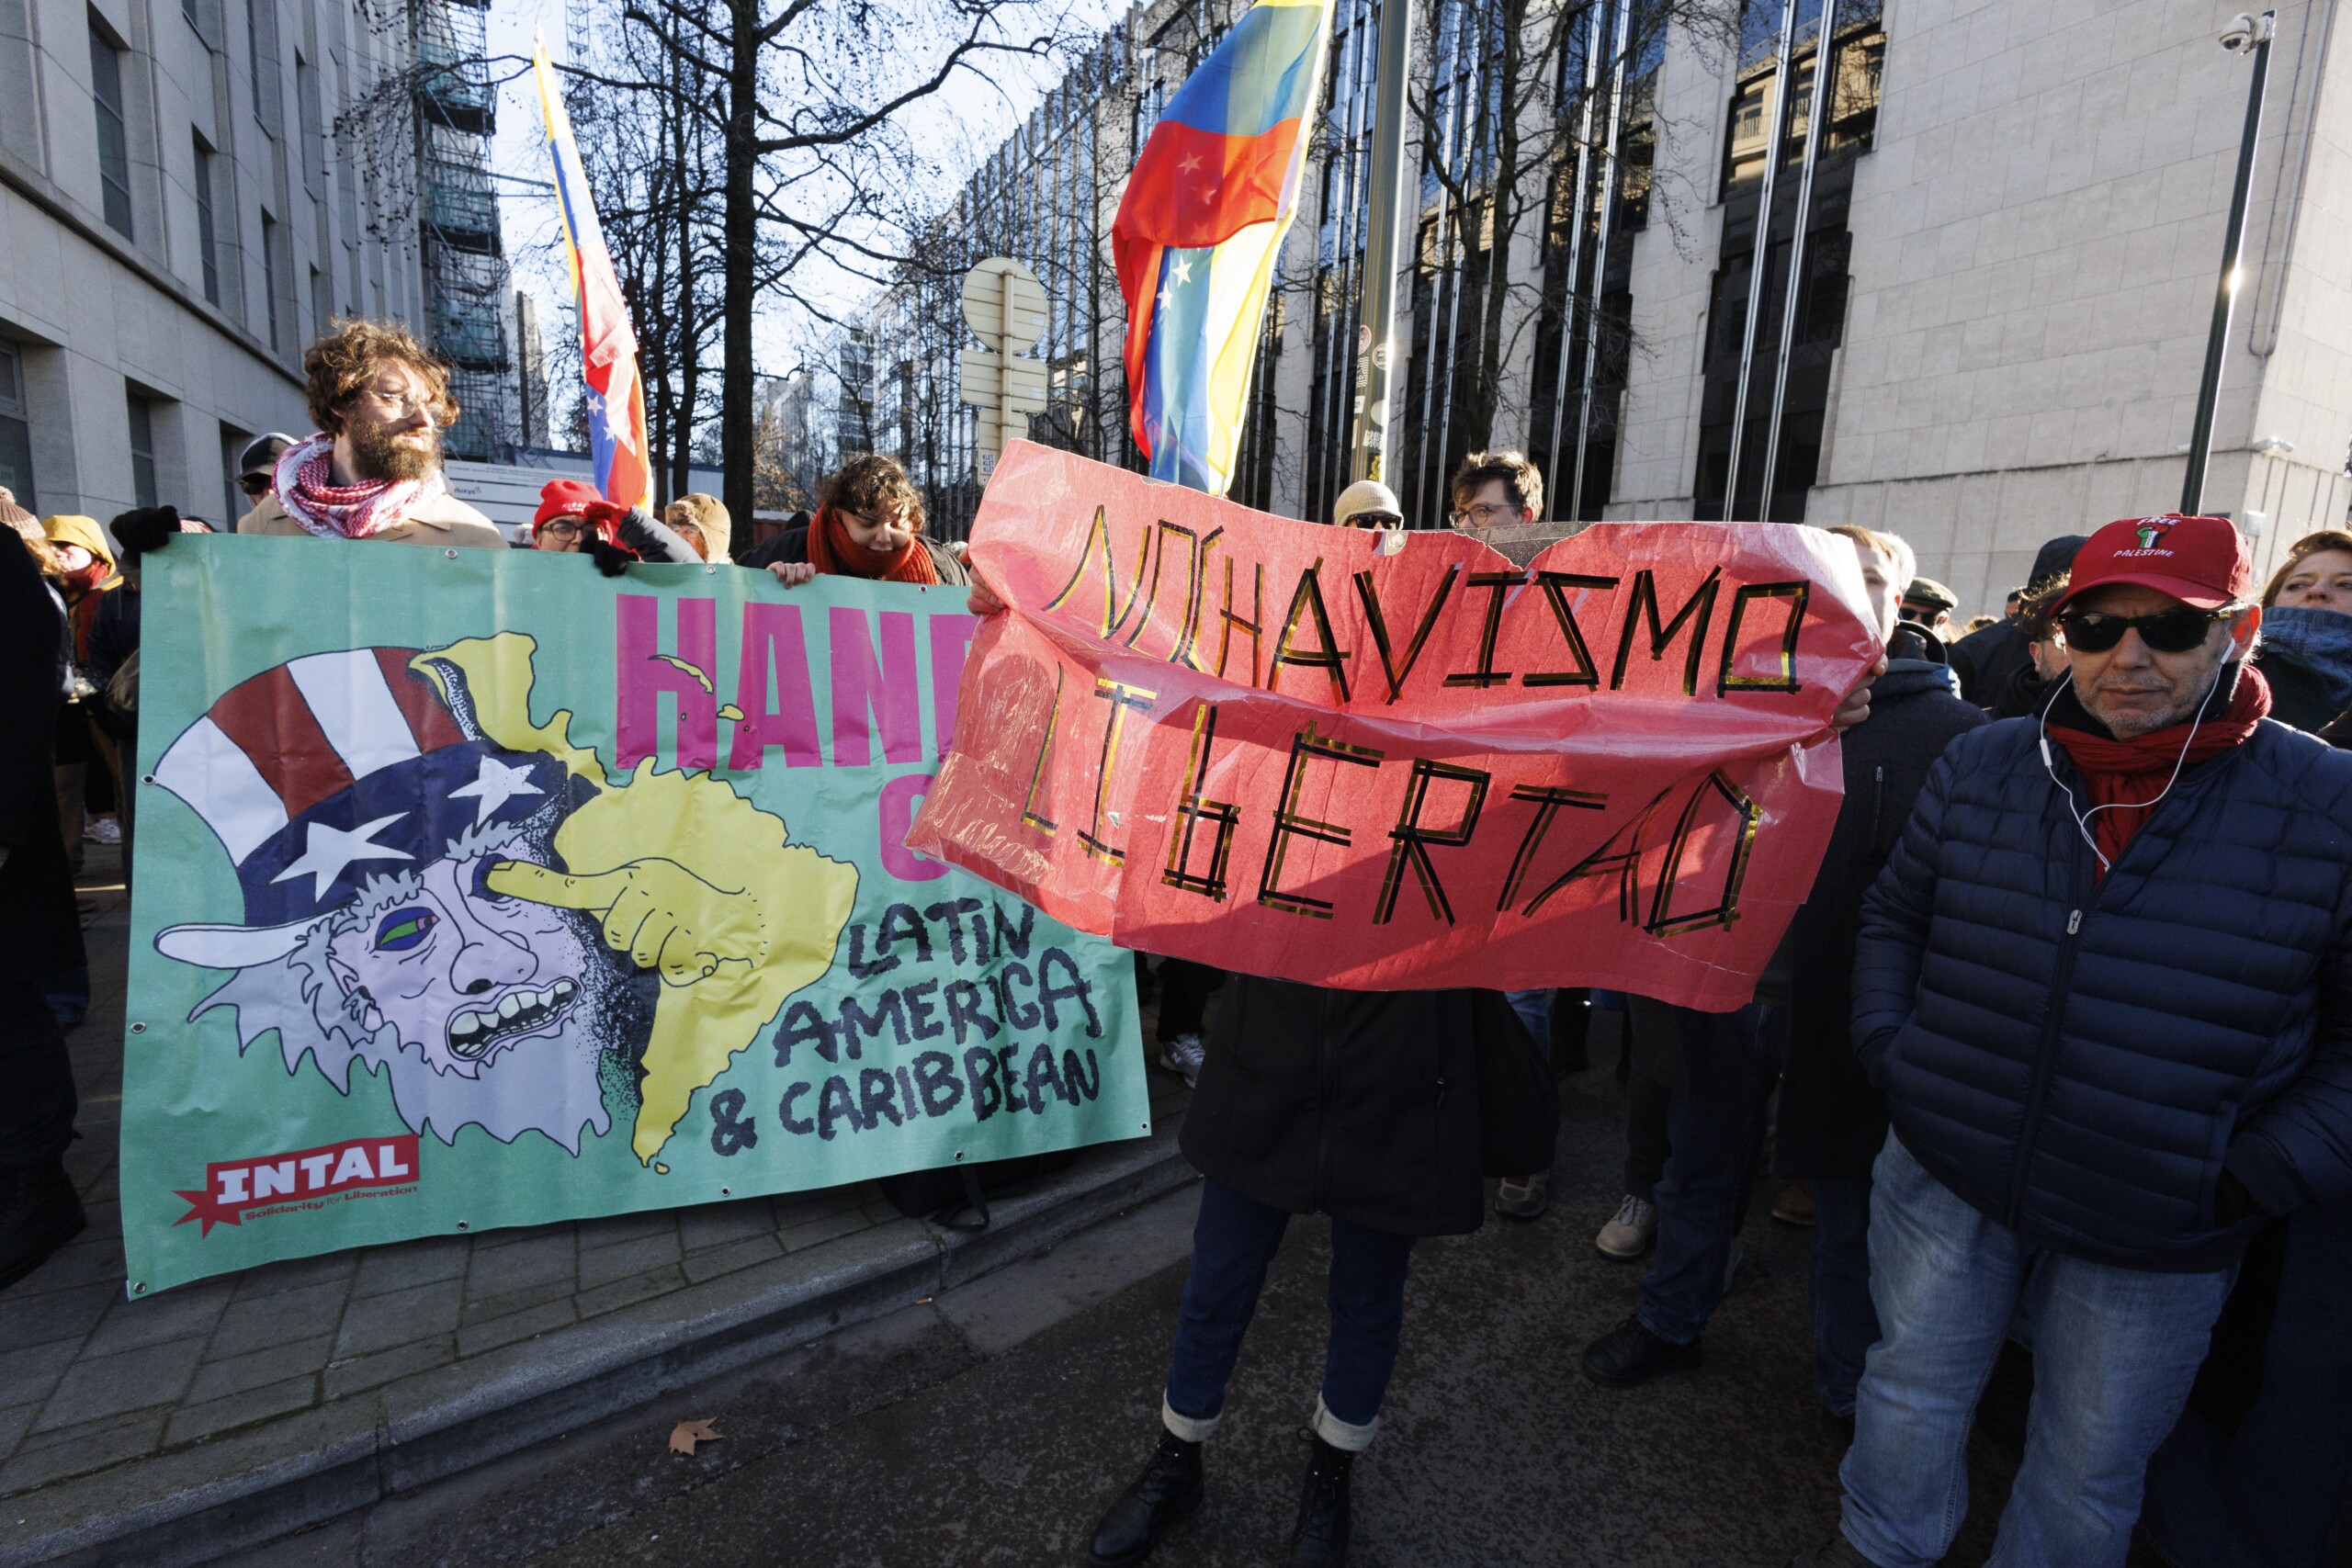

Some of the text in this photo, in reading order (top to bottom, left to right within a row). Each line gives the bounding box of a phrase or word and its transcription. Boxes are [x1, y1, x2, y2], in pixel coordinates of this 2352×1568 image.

[2136, 516, 2182, 525] FREE
[2113, 548, 2175, 558] PALESTINE
[848, 897, 1035, 979] LATIN
[773, 946, 1102, 1067] AMERICA
[709, 1042, 1100, 1156] & CARIBBEAN
[217, 1145, 409, 1205] INTAL
[245, 1185, 418, 1220] Solidarity for Liberation
